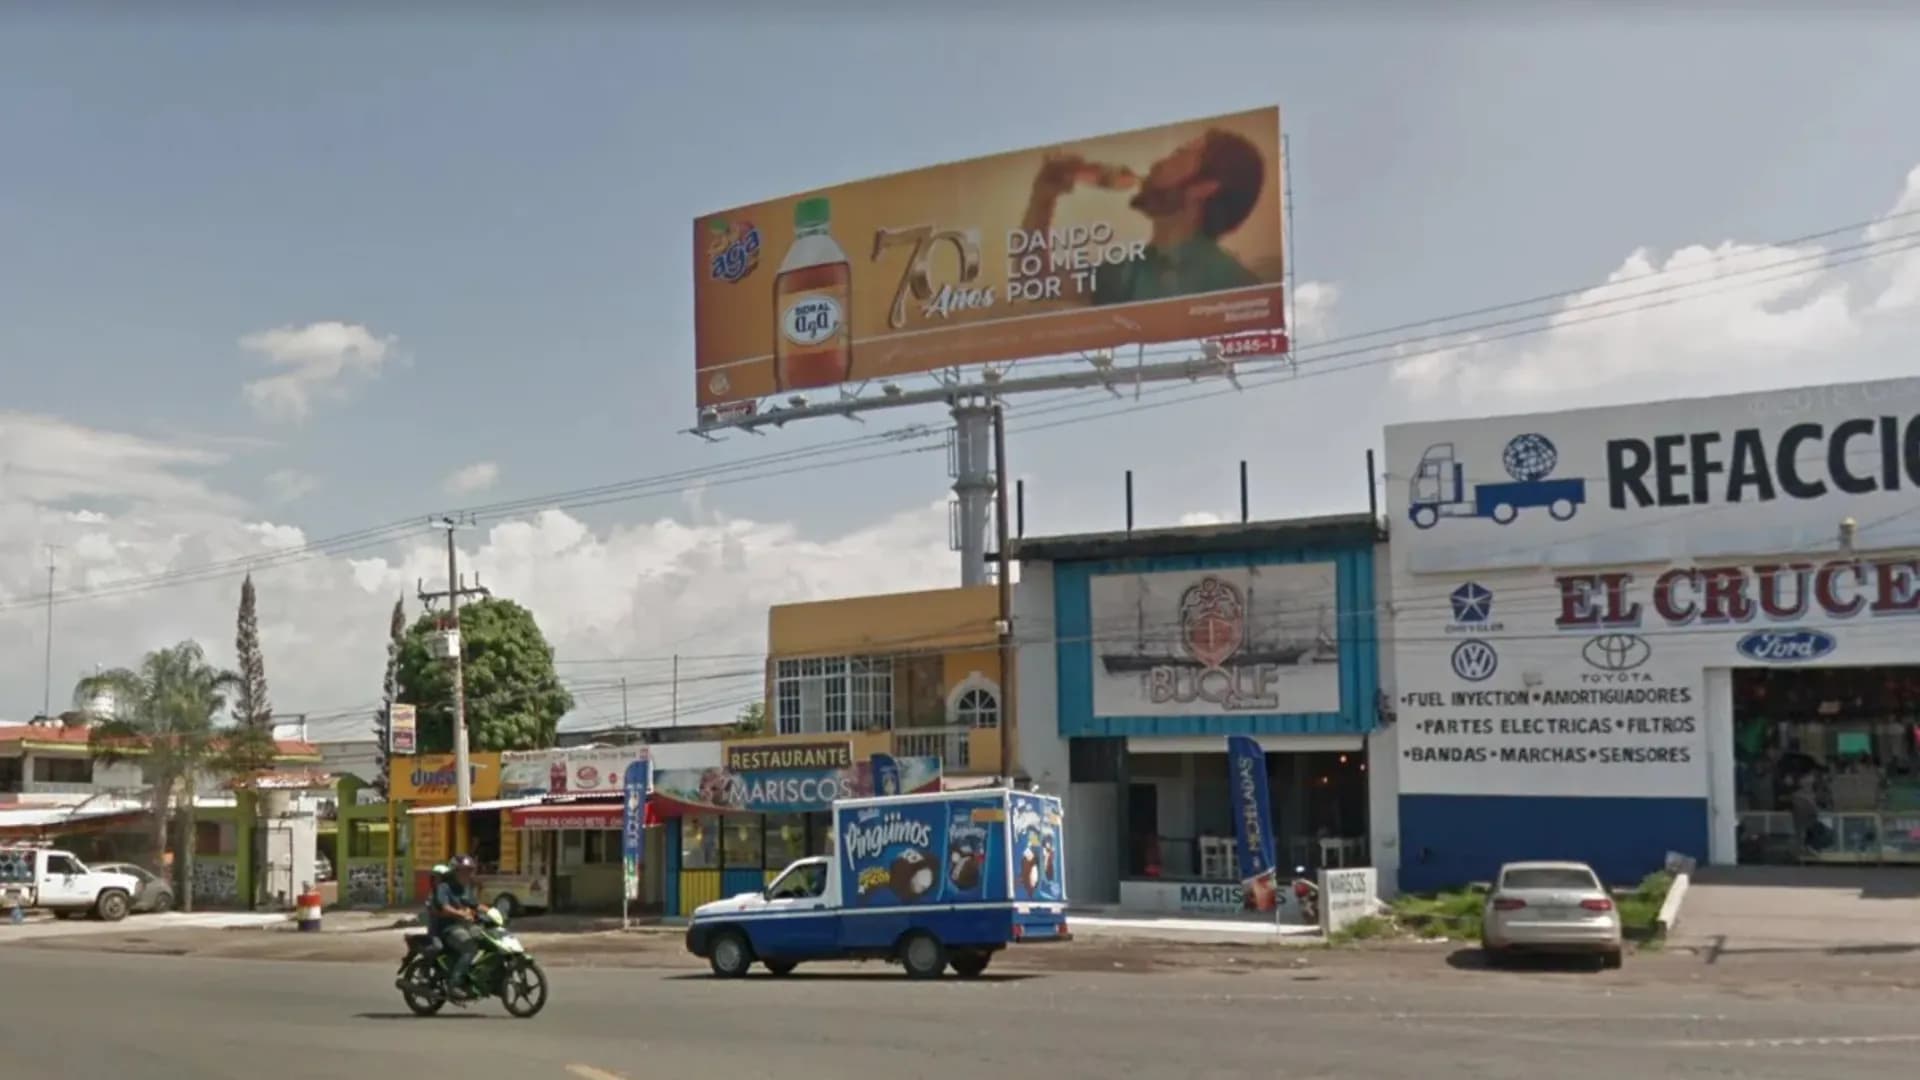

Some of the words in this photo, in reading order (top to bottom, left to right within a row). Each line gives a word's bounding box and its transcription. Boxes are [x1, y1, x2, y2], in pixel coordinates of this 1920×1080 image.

[1008, 223, 1114, 256] DANDO
[711, 227, 762, 280] aga
[1008, 255, 1042, 280] LO
[1050, 240, 1146, 271] MEJOR
[871, 225, 982, 328] 70
[1008, 276, 1061, 303] POR
[1555, 571, 1641, 629] EL
[1652, 558, 1920, 624] CRUCE
[1754, 635, 1815, 658] Ford
[1151, 665, 1279, 703] BUQUE
[1580, 672, 1654, 684] TOYOTA
[1408, 692, 1445, 707] FUEL
[1451, 690, 1530, 707] INYECTION
[1541, 687, 1692, 705] AMORTIGUADORES
[1424, 718, 1493, 735] PARTES
[1501, 717, 1612, 735] ELECTRICAS
[1627, 716, 1696, 733] FILTROS
[731, 747, 848, 769] RESTAURANTE
[1412, 747, 1487, 763] BANDAS
[1501, 747, 1587, 763] MARCHAS
[1600, 747, 1691, 763] SENSORES
[728, 778, 851, 804] MARISCOS
[844, 812, 932, 872] Pingüinos
[1181, 885, 1287, 905] MARISS
